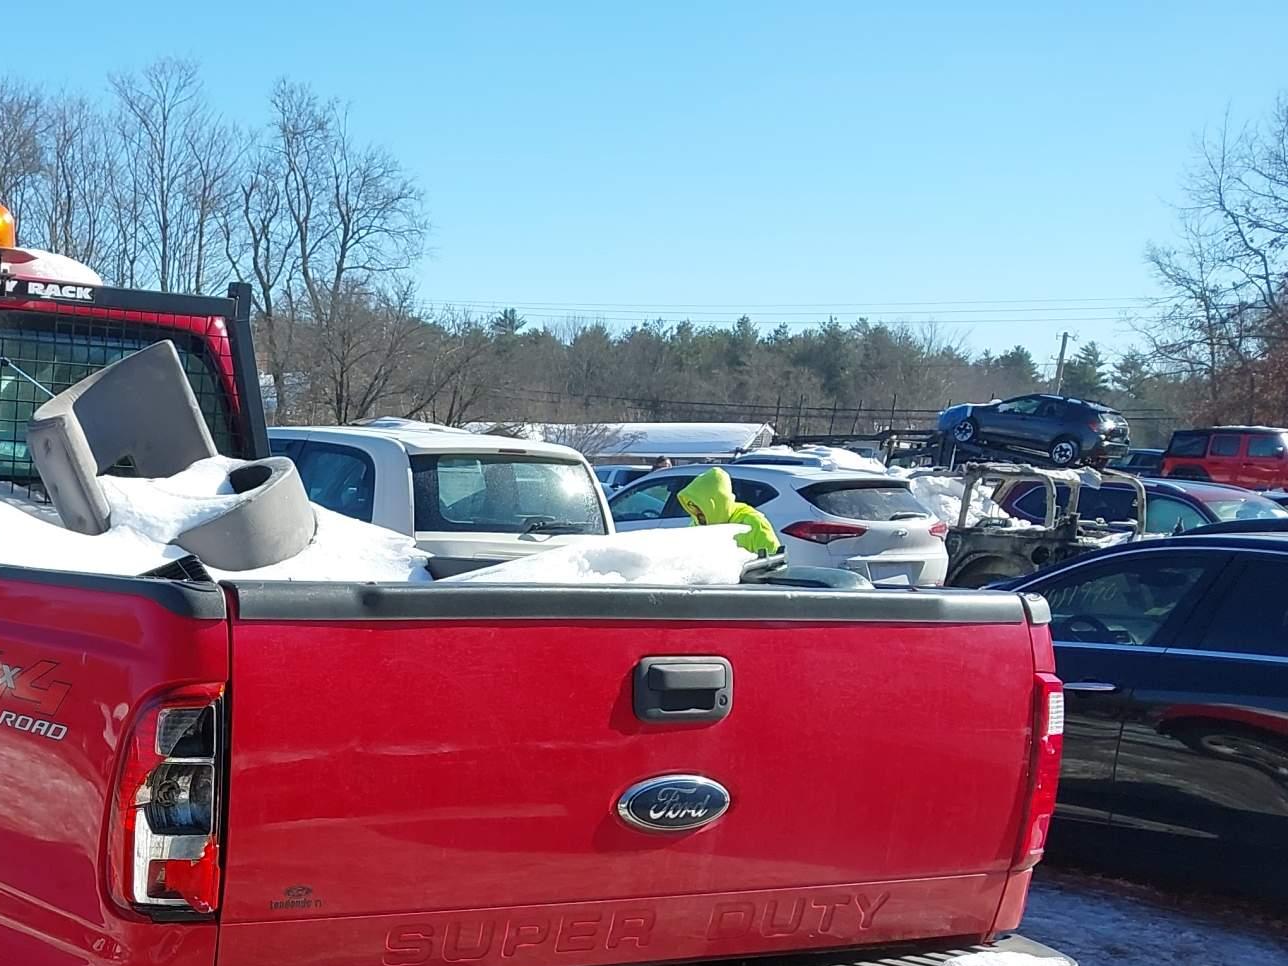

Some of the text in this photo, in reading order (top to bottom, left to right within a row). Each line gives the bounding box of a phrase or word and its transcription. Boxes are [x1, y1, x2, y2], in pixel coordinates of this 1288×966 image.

[27, 282, 92, 300] RACK
[648, 787, 712, 820] Ford
[383, 890, 890, 966] SUPER DUTY
